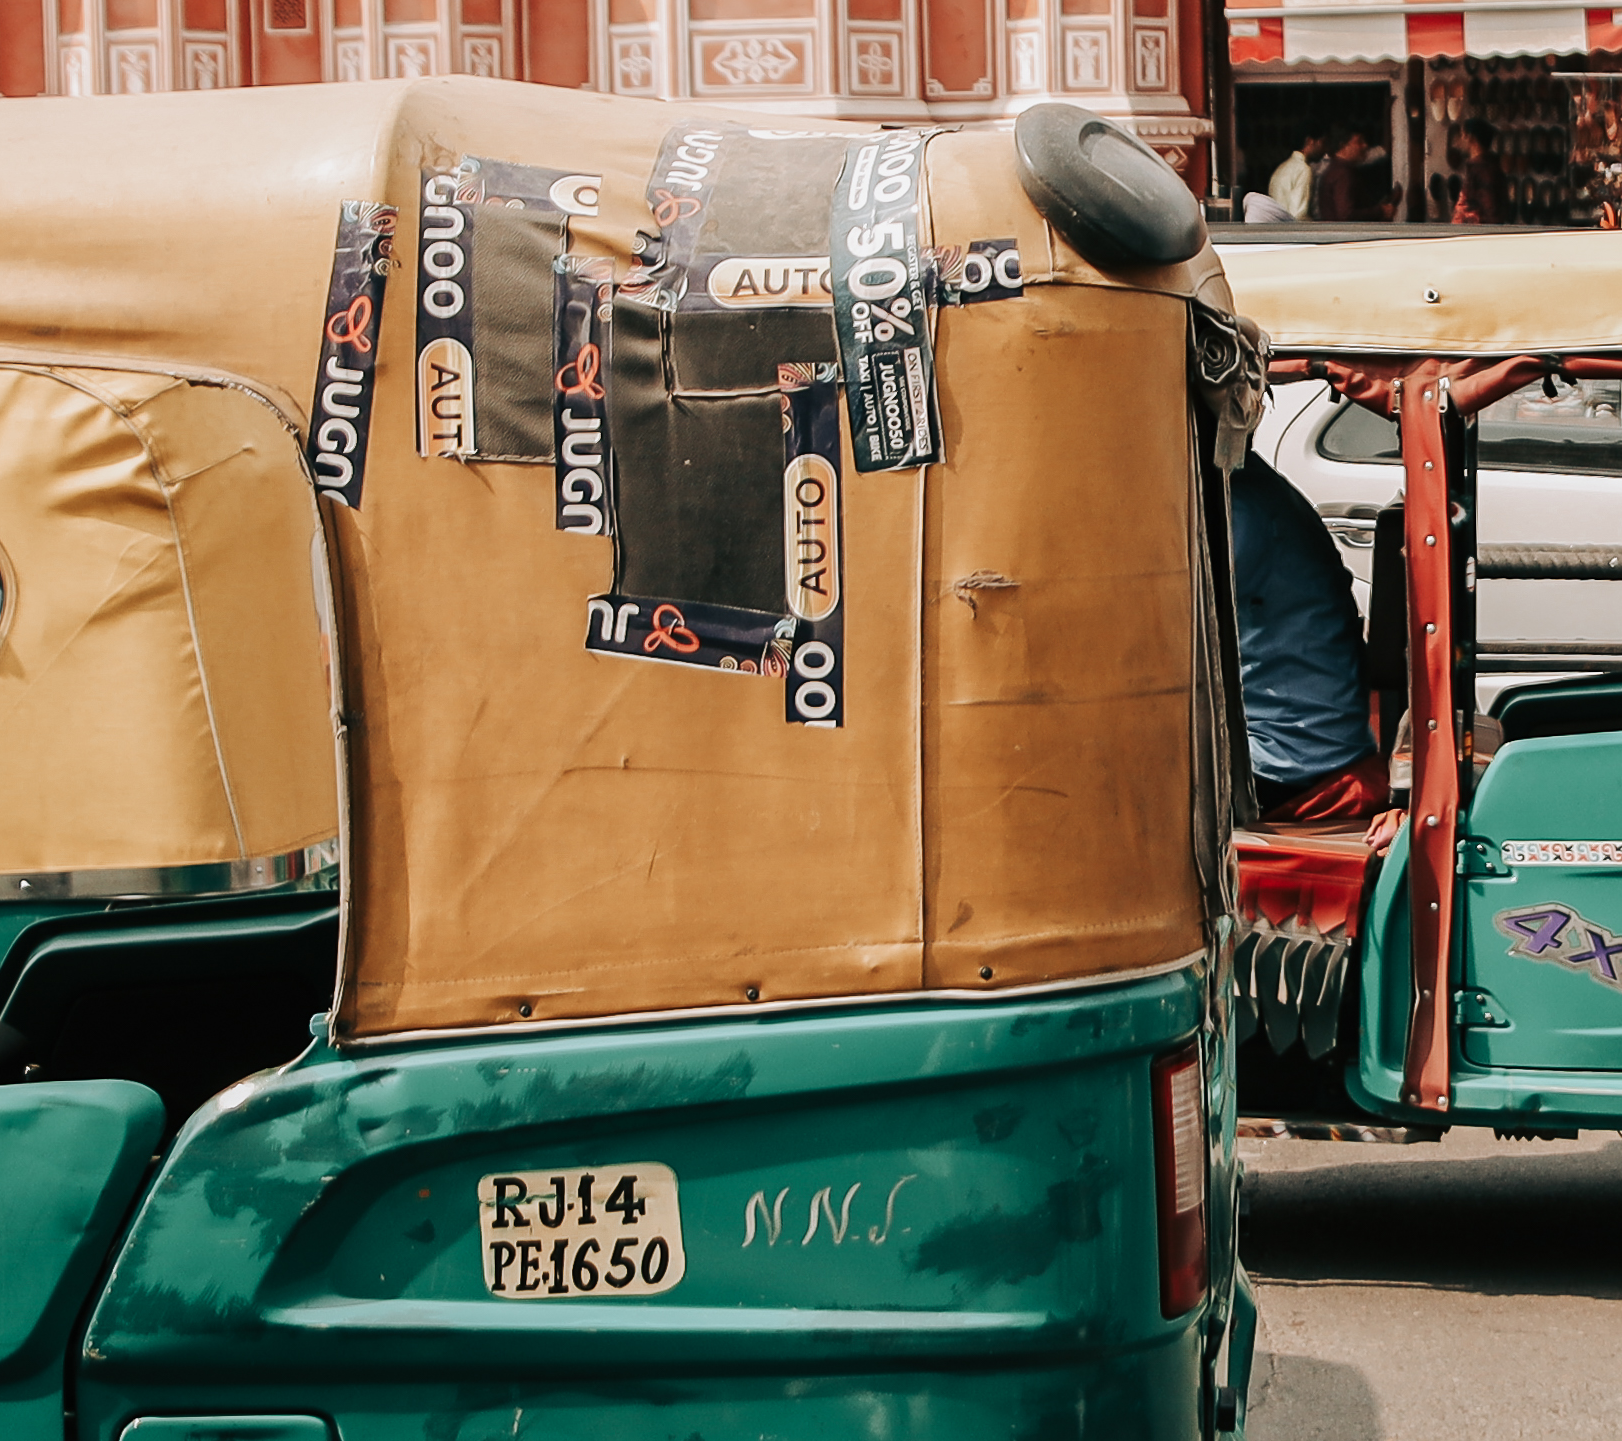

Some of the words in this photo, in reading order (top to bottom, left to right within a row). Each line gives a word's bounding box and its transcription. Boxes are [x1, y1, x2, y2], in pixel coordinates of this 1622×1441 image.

[851, 302, 874, 343] OFF
[858, 355, 872, 383] TAXI
[863, 393, 877, 425] AUTO
[879, 362, 905, 451] JUGNOO50
[796, 477, 828, 597] AUTO
